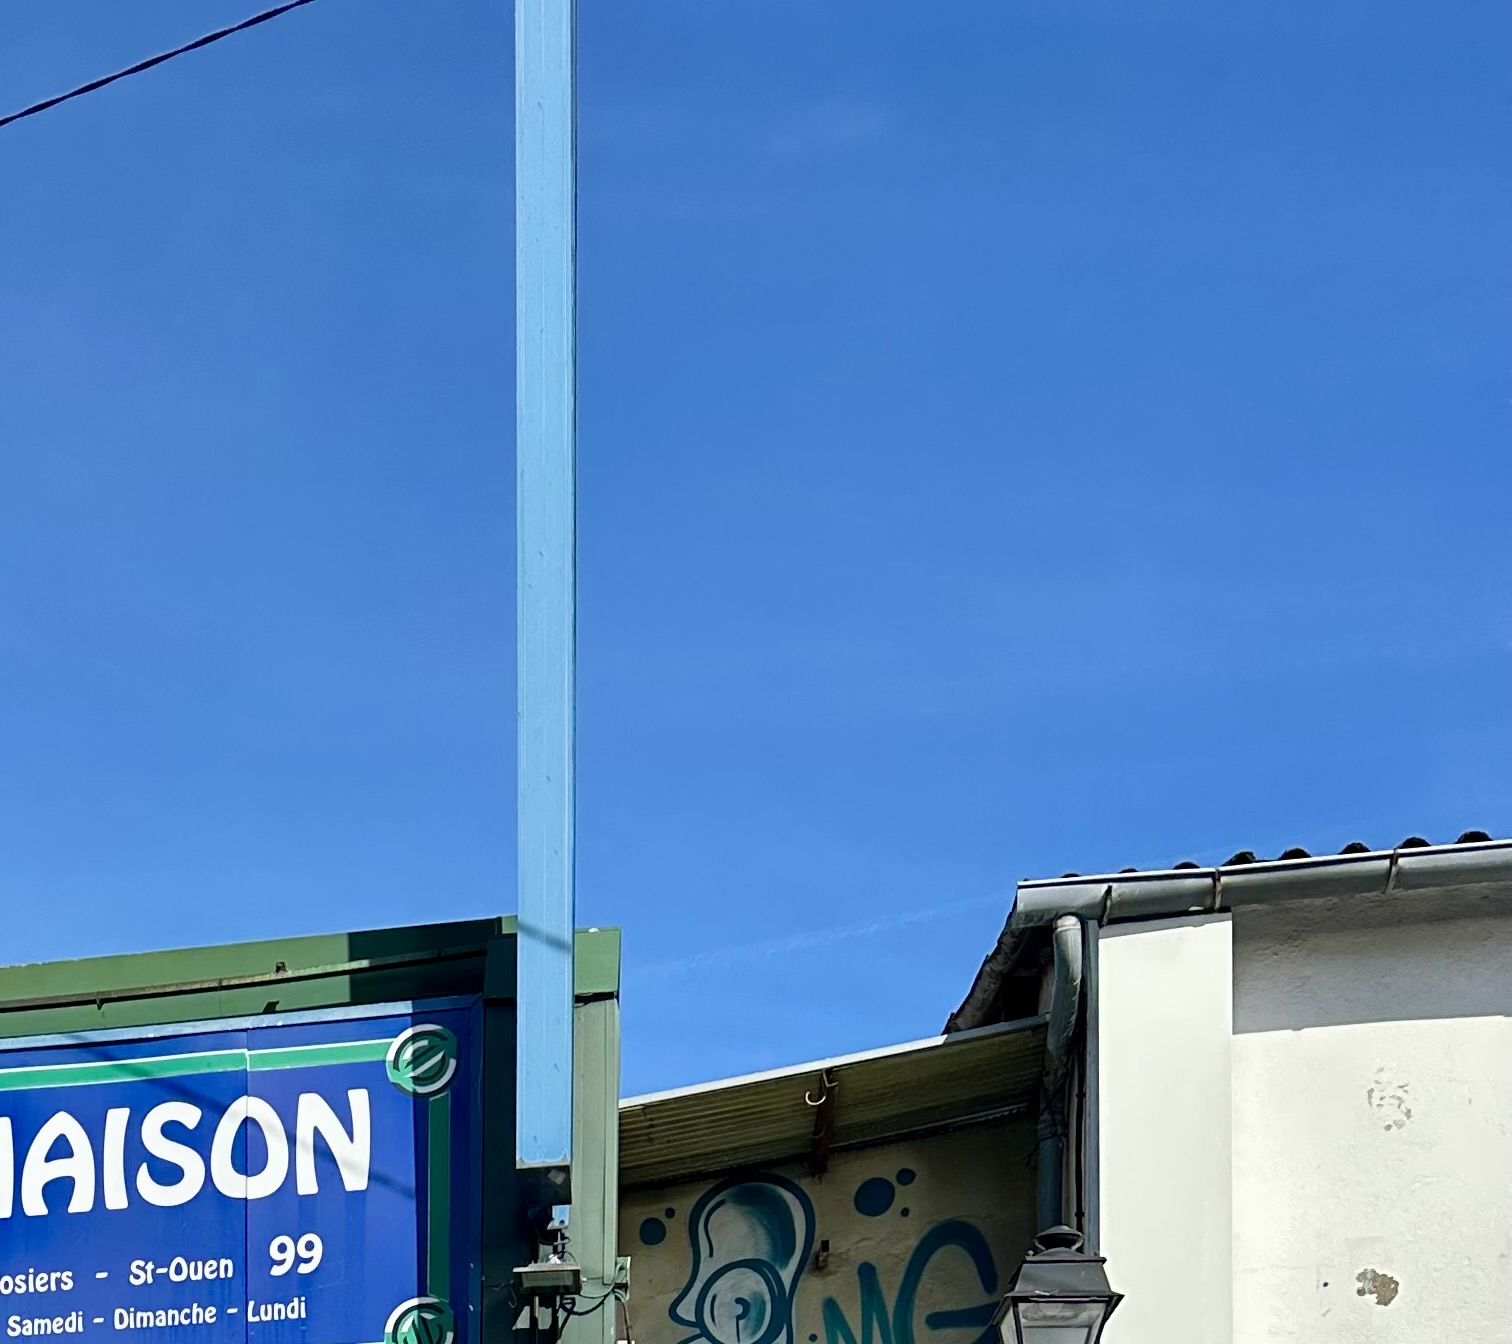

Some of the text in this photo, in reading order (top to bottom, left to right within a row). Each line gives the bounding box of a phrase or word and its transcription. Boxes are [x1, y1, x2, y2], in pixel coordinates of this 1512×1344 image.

[129, 1256, 234, 1286] St-Ouen
[269, 1232, 323, 1277] 99
[6, 1312, 85, 1337] Samedi
[113, 1306, 217, 1331] Dimanche
[247, 1297, 307, 1322] Lundi
